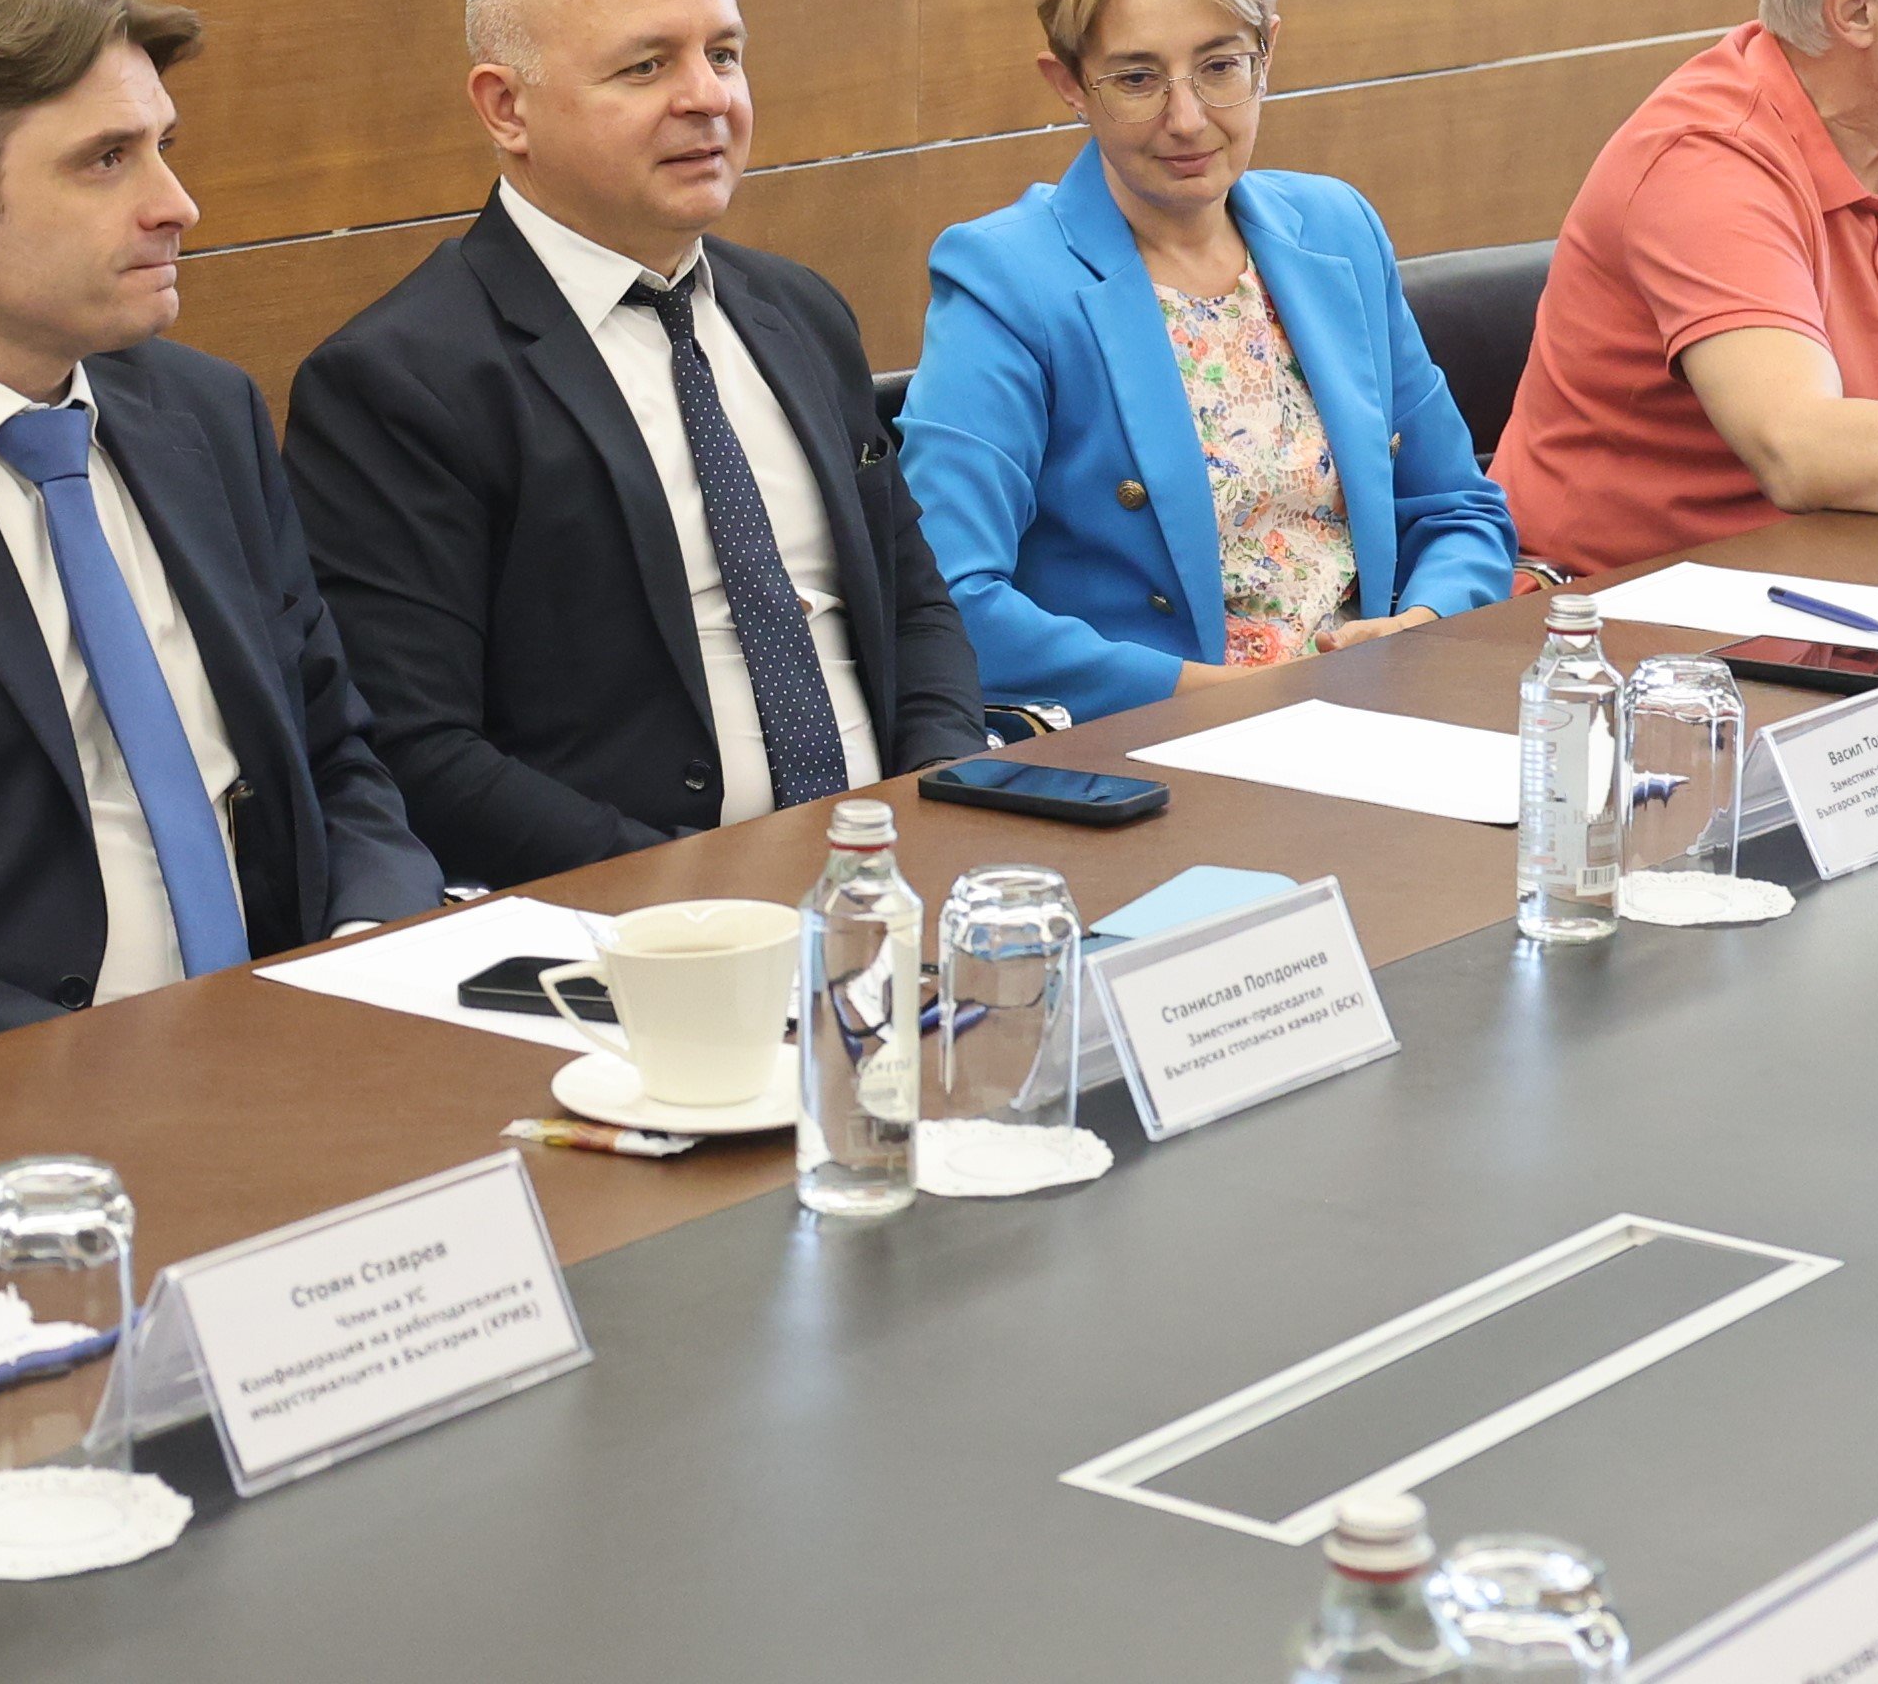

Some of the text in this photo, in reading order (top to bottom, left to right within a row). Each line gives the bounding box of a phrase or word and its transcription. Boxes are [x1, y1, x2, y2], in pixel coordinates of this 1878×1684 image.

[1828, 743, 1863, 766] Васил
[1816, 792, 1860, 819] Българска
[1162, 951, 1328, 1023] Станислав Попдончев
[1187, 986, 1323, 1047] Заместник-председател
[1164, 991, 1364, 1079] Българска стопанска камара (БСК)
[291, 1240, 447, 1308] Стоян Ставрев
[240, 1338, 365, 1395] Конфедерация
[371, 1331, 390, 1346] на
[394, 1283, 518, 1343] работодателите
[336, 1287, 427, 1329] Член на УС
[404, 1327, 478, 1366] България
[483, 1302, 541, 1339] (КРИБ)
